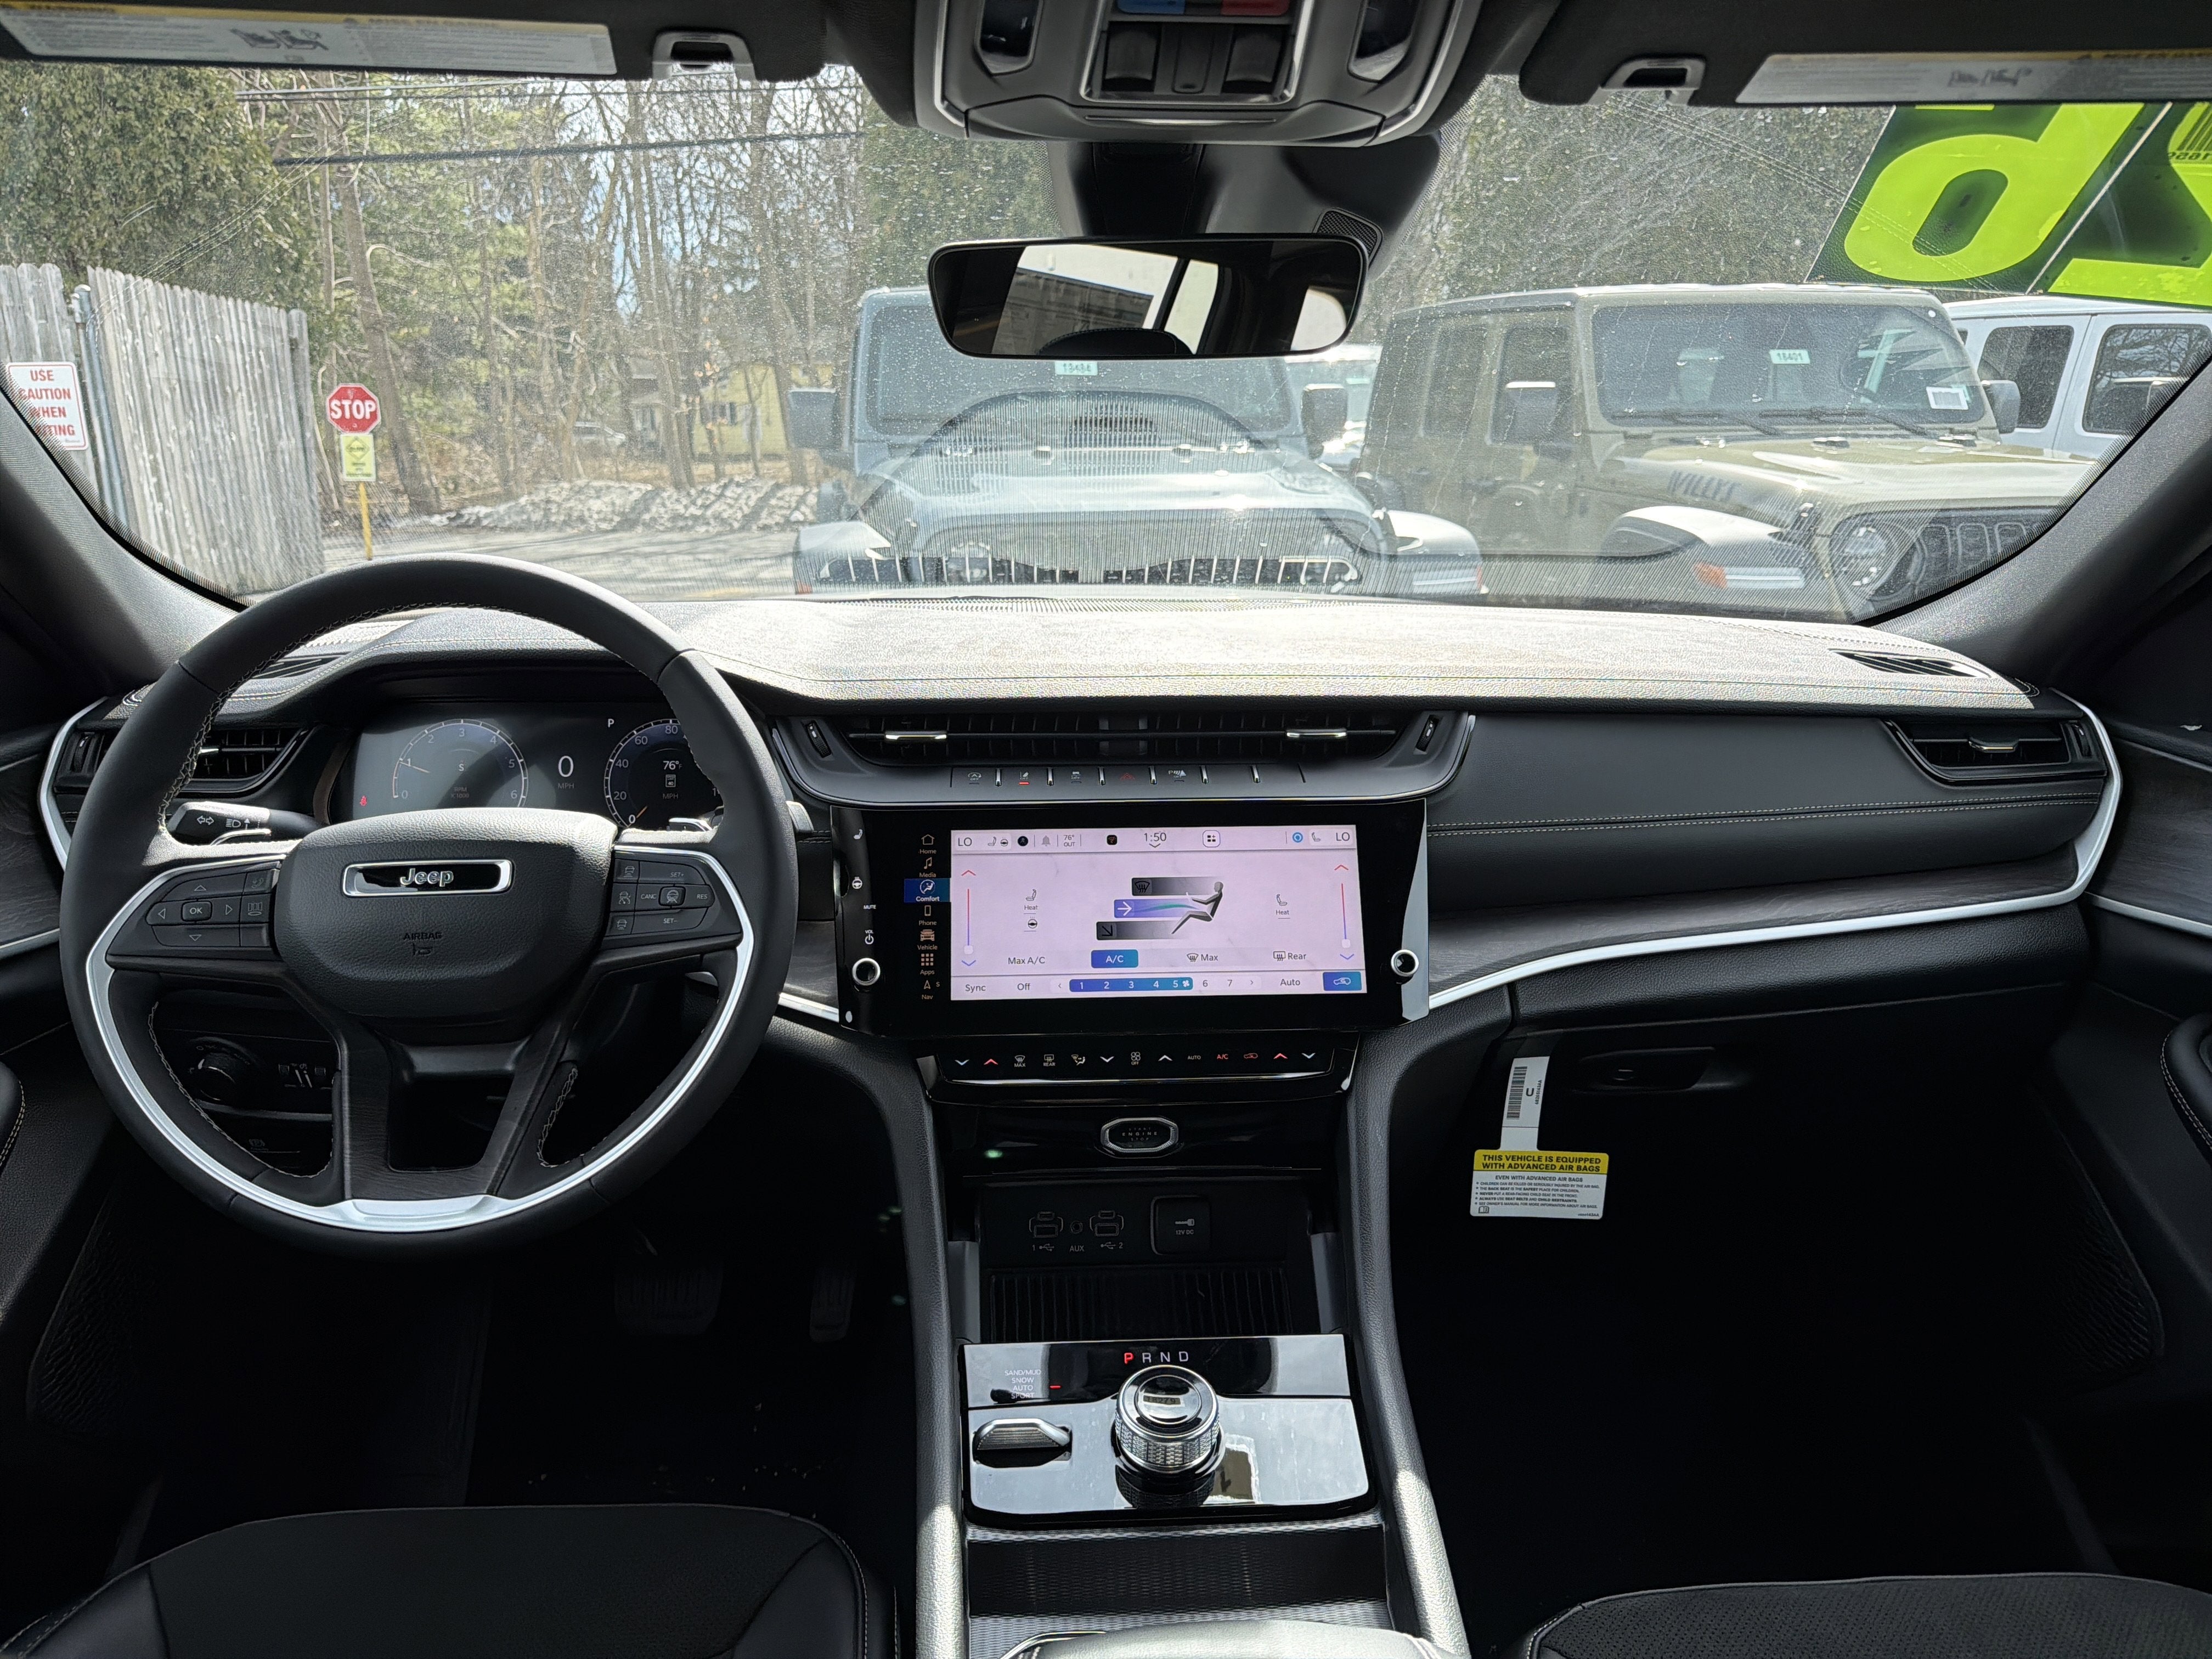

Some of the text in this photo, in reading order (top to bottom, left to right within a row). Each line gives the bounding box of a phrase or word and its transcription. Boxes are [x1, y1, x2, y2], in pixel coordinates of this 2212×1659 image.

[30, 369, 54, 381] USE
[19, 388, 71, 400] CAUTION
[330, 399, 376, 420] STOP
[608, 719, 614, 727] P
[459, 729, 465, 737] 3
[665, 725, 678, 734] 80
[428, 735, 435, 743] 2
[635, 736, 648, 745] 60
[407, 758, 411, 766] 1
[509, 759, 515, 768] 5
[558, 755, 574, 777] 0
[616, 759, 629, 768] 40
[402, 790, 408, 799] 0
[511, 790, 517, 799] 6
[614, 791, 627, 800] 20
[629, 815, 636, 823] 0
[958, 837, 972, 847] LO
[1144, 832, 1167, 842] 1:50
[1335, 832, 1350, 842] LO
[400, 868, 454, 887] Jeep
[403, 932, 443, 940] AIRBAG
[1008, 956, 1046, 966] Max A/C
[1105, 955, 1124, 964] A/C
[1201, 953, 1218, 962] Max
[1288, 952, 1307, 961] Rear
[1017, 983, 1031, 991] Off
[1173, 980, 1178, 988] 5
[1280, 979, 1301, 987] Auto
[965, 983, 986, 994] Sync
[1526, 1088, 1534, 1097] U
[1556, 1156, 1601, 1164] EQUIPPED
[1124, 1351, 1189, 1364] P R N D
